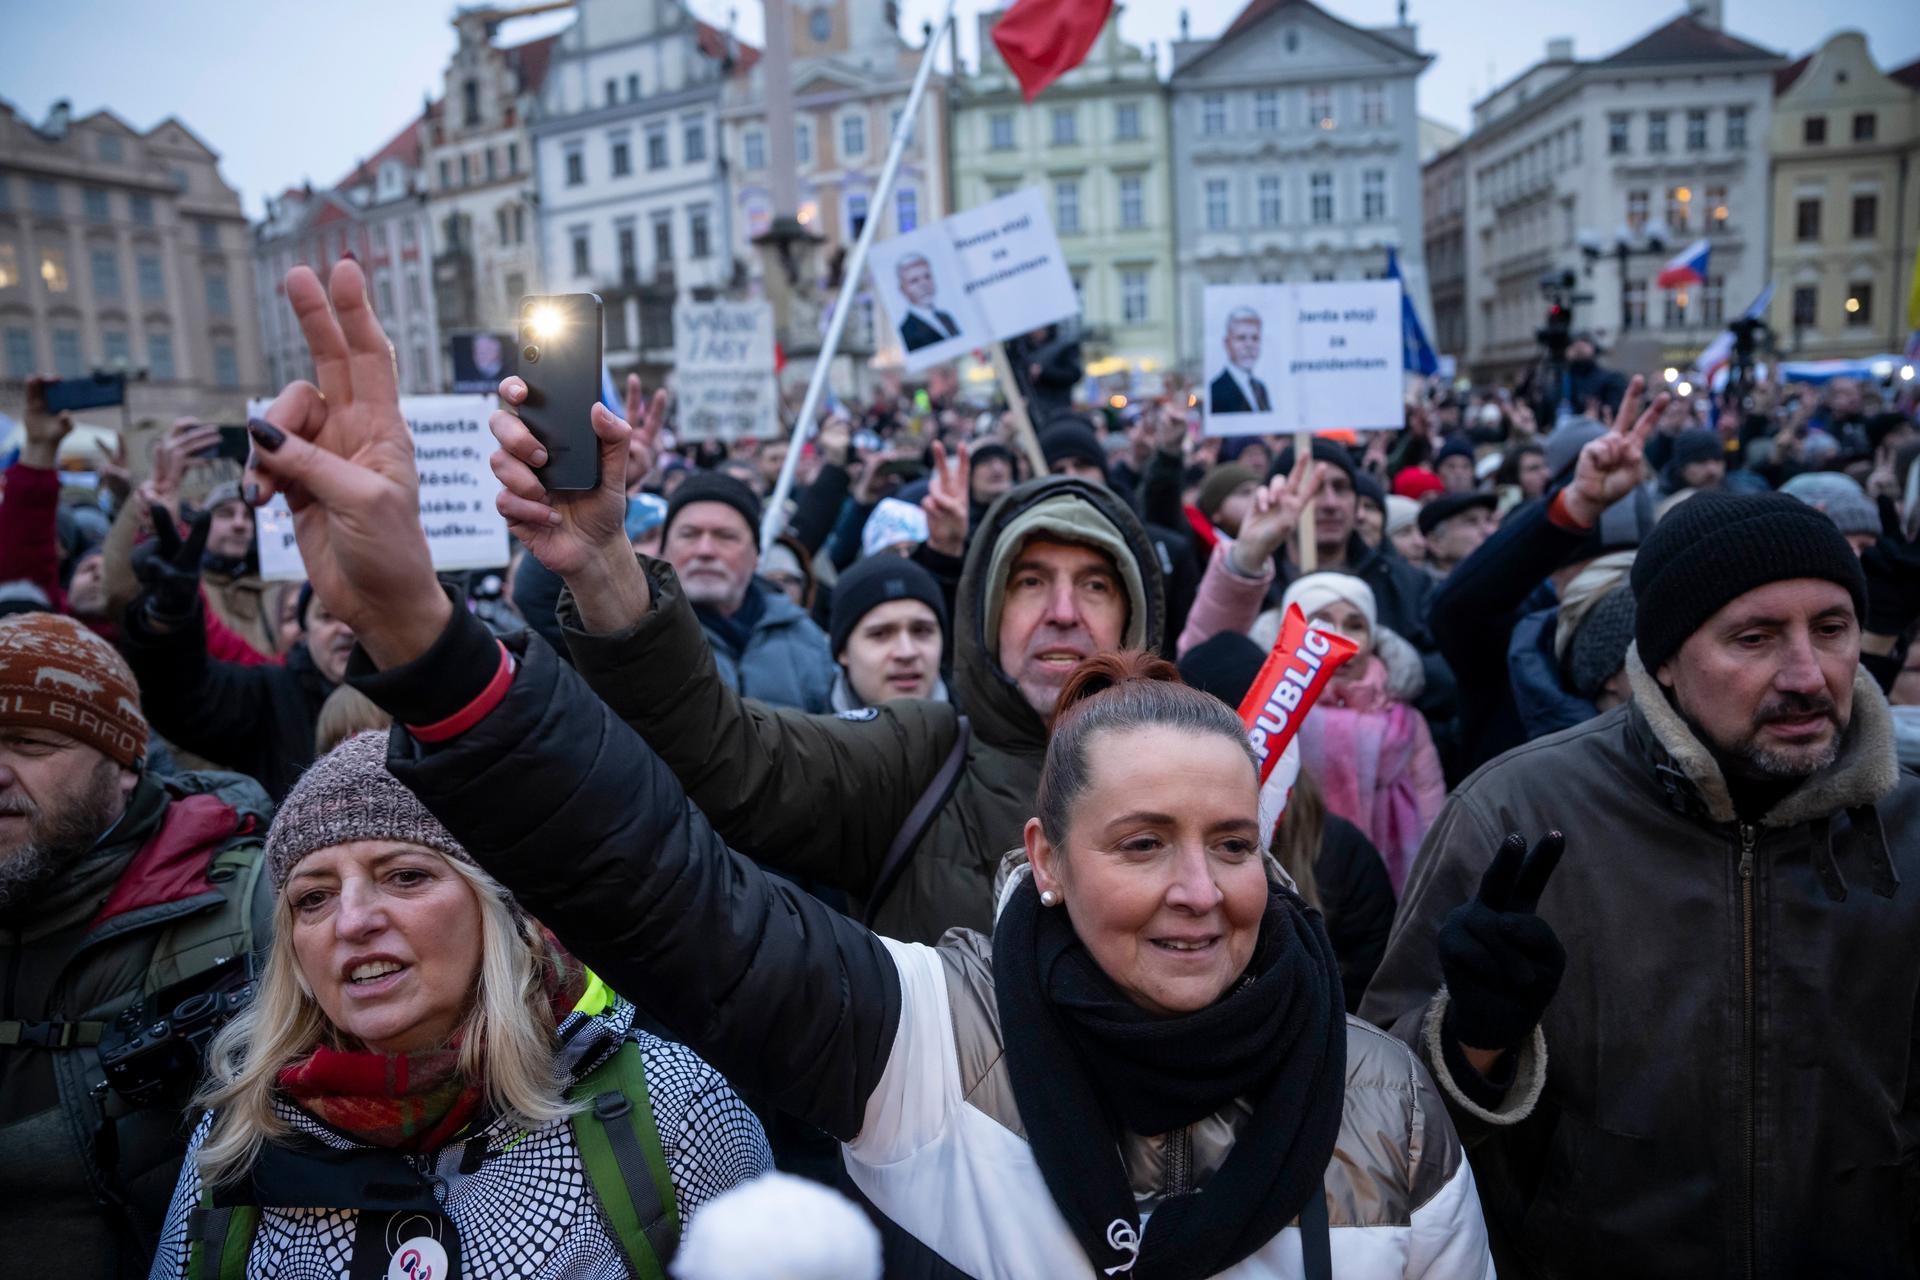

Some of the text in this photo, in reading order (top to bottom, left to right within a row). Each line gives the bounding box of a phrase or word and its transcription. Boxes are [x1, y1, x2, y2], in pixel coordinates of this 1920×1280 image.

[964, 255, 1048, 294] prezidentem
[1299, 308, 1338, 321] Jarda
[1330, 336, 1346, 347] za
[1290, 358, 1386, 374] prezidentem
[407, 418, 479, 432] laneta
[415, 447, 480, 460] lunce,
[1248, 628, 1330, 766] PUBLIC
